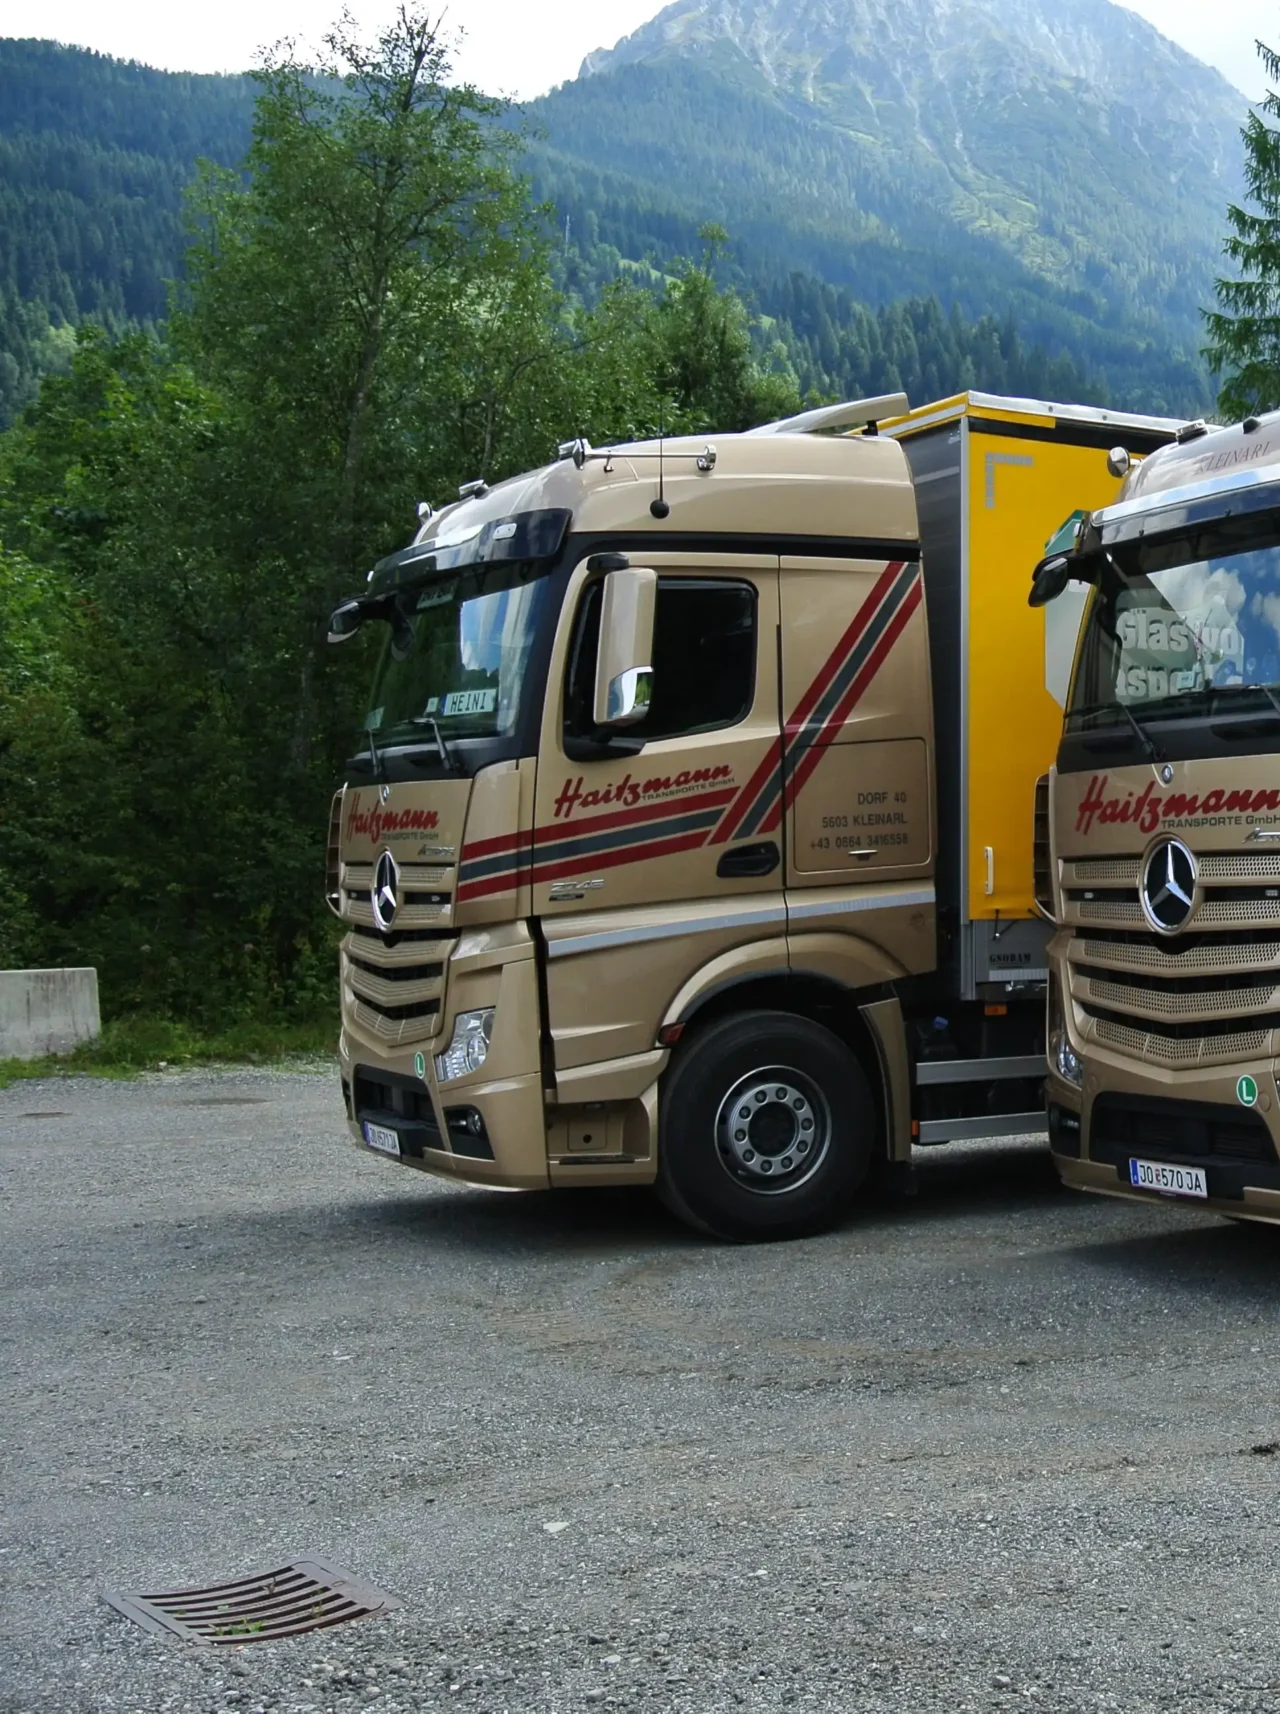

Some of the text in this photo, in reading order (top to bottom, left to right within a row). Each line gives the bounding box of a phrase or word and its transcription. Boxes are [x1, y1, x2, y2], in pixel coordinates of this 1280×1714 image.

[1116, 609, 1189, 652] Glas
[451, 691, 487, 713] HEINI
[553, 764, 732, 819] Haitzmann
[642, 782, 707, 801] TRANSPORTE
[857, 791, 907, 805] DORF 40
[822, 812, 908, 828] 5603 KLEINARL
[1161, 816, 1242, 829] TRANSPORTE
[1139, 1164, 1203, 1193] JO 570 JA
